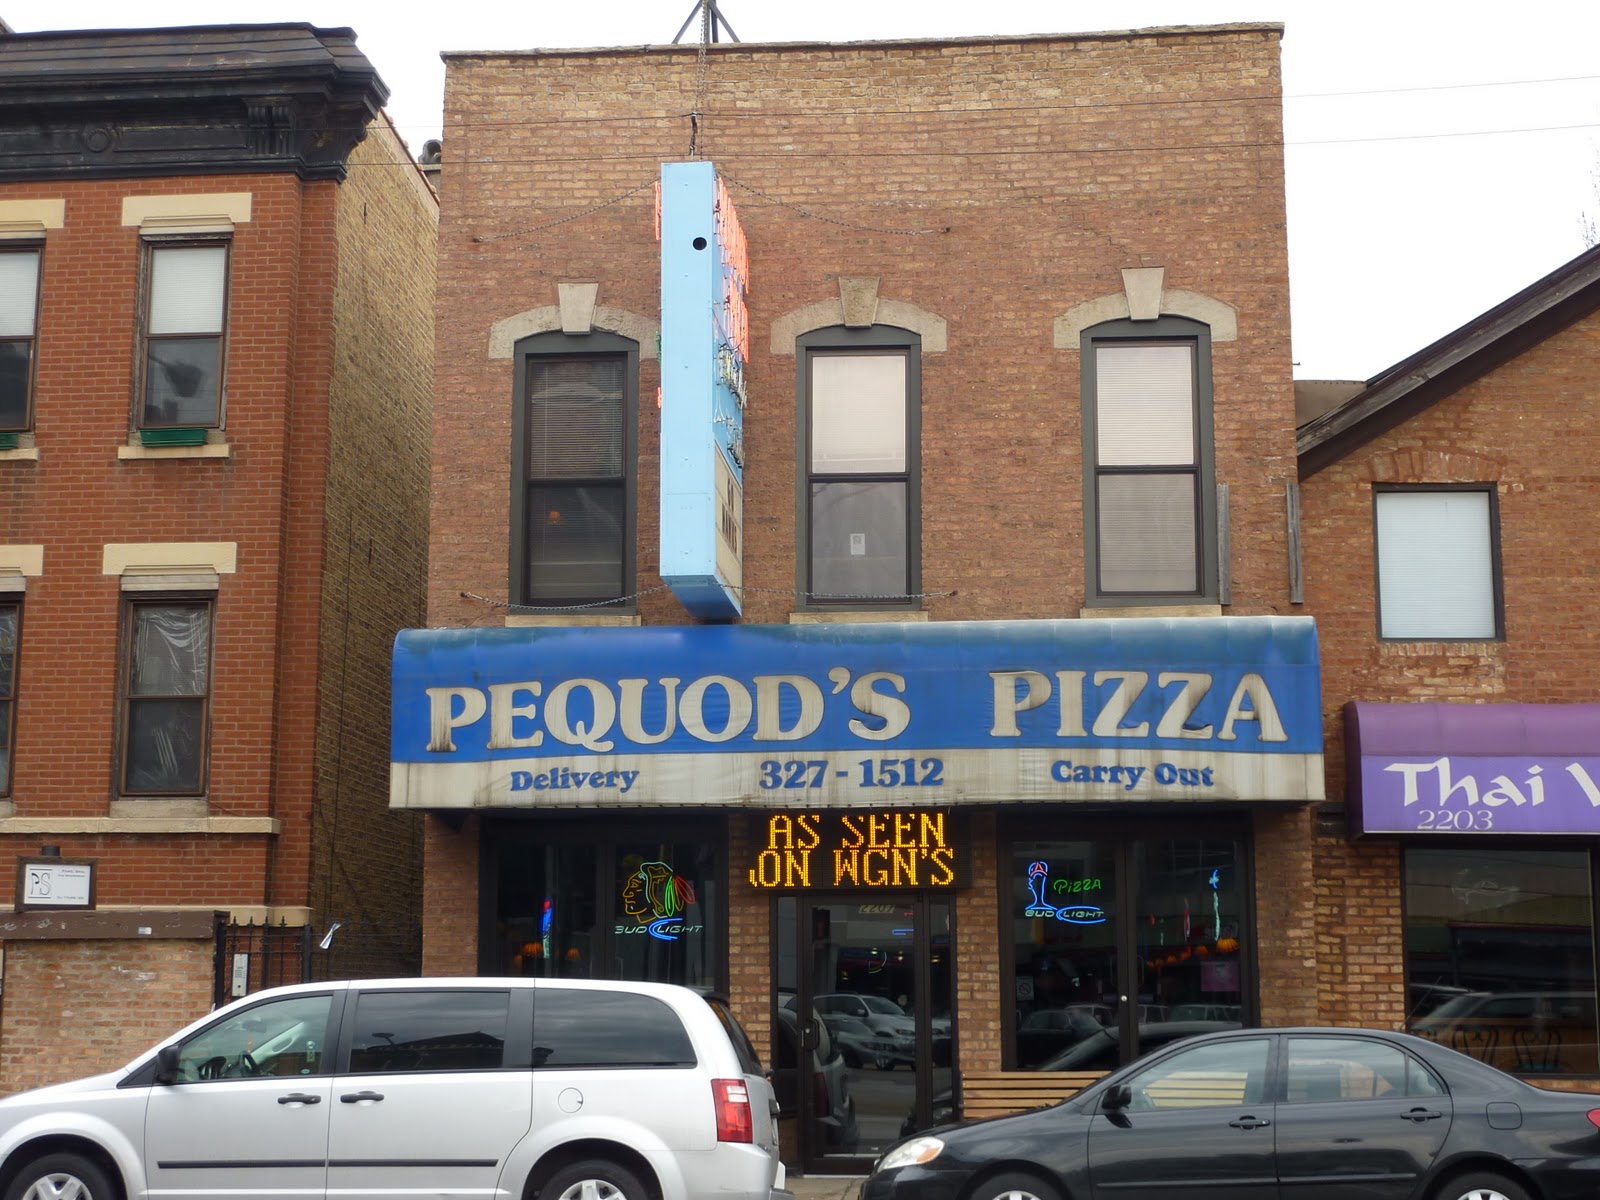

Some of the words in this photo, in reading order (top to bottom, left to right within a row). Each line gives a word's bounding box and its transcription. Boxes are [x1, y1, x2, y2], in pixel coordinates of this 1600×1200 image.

[425, 666, 911, 753] PEQUOD'S
[988, 669, 1289, 742] PIZZA
[510, 767, 640, 793] Delivery
[1050, 759, 1146, 791] Carry
[1154, 762, 1215, 787] Out
[1383, 757, 1545, 807] Thai
[767, 814, 820, 849] AS
[841, 813, 946, 848] SEEN
[1416, 809, 1494, 831] 2203
[833, 848, 954, 886] WGN'S
[656, 925, 704, 934] LIGHT
[1024, 909, 1055, 918] BUD
